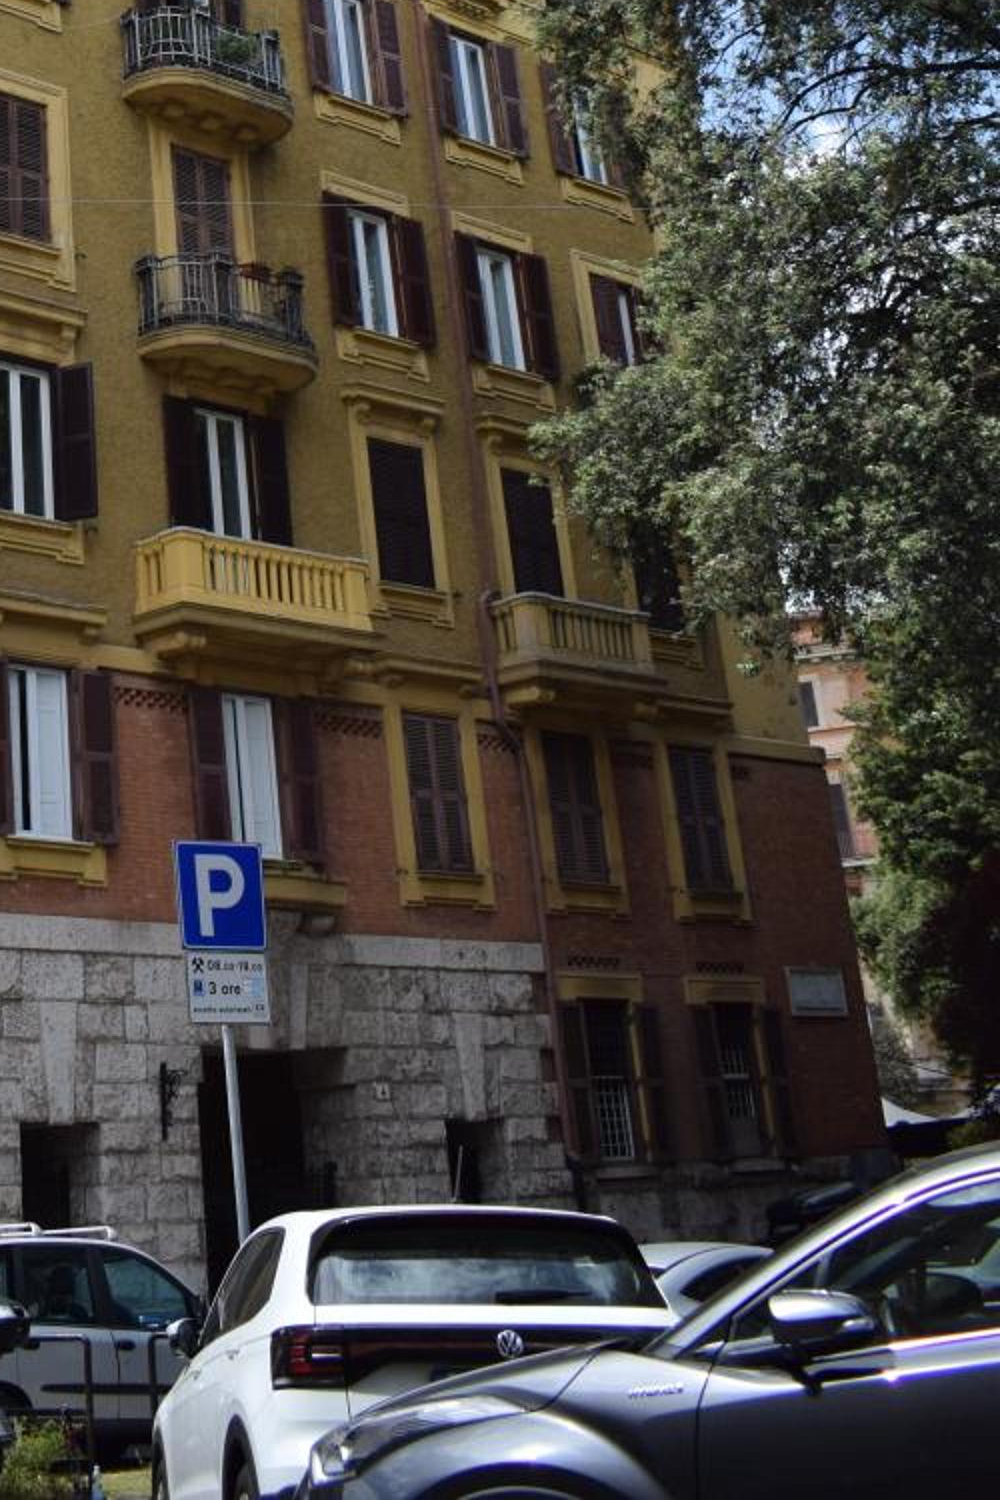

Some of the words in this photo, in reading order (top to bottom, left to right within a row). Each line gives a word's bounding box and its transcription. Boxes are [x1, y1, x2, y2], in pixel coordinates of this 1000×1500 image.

[194, 854, 244, 937] P
[209, 982, 217, 995] 3
[221, 984, 241, 995] ore
